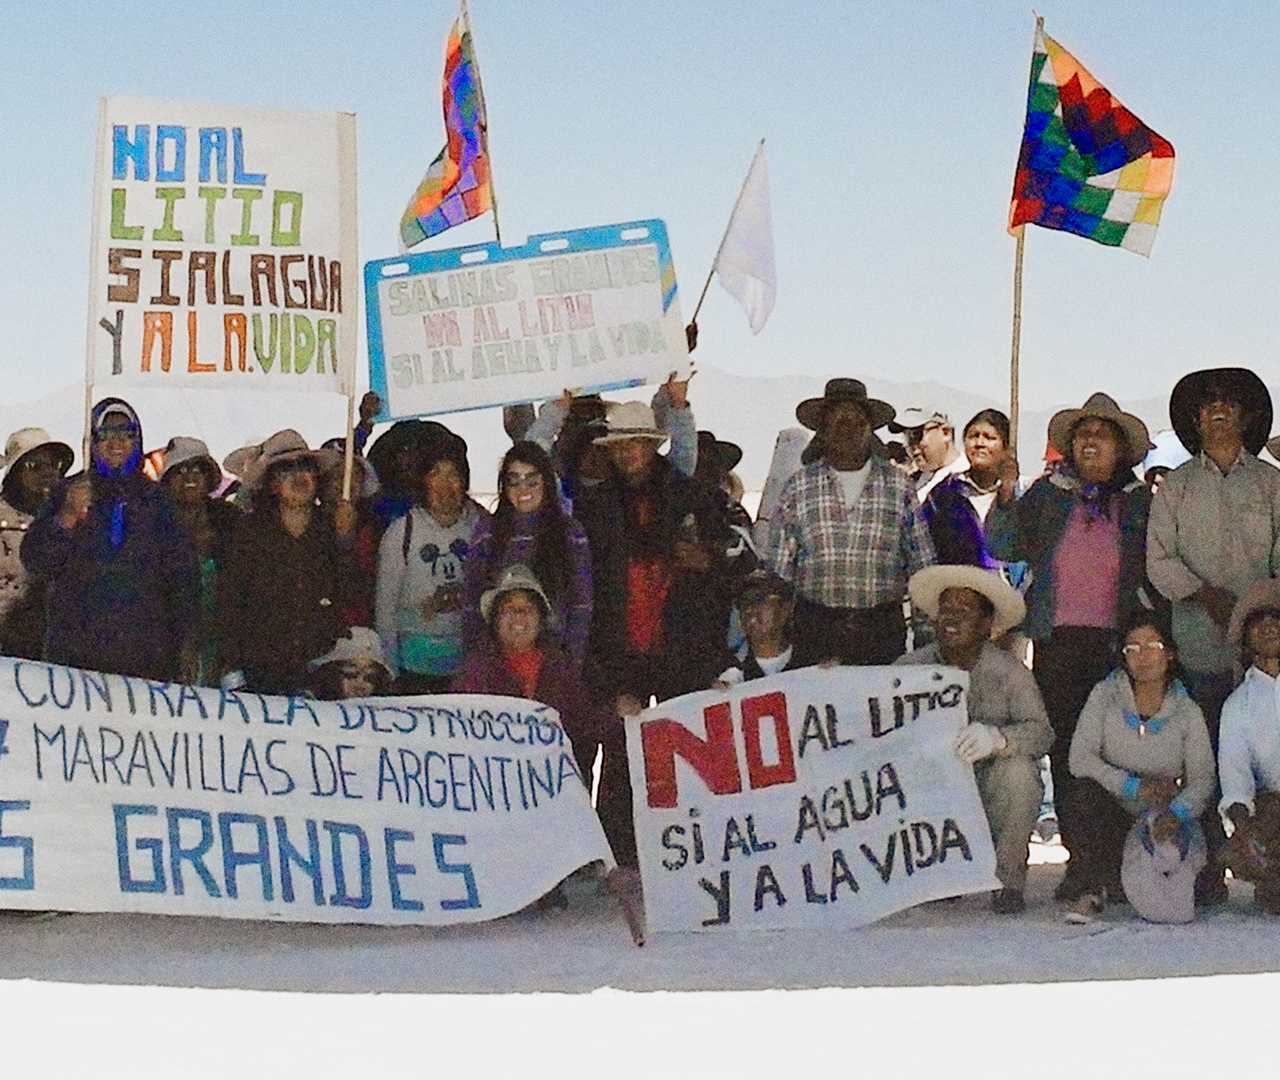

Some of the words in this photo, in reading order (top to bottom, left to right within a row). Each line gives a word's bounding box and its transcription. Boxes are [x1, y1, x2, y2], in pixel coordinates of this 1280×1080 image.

[112, 124, 186, 182] NO
[198, 126, 267, 186] AL
[110, 186, 303, 246] LITIO
[389, 265, 518, 316] SALINAS
[98, 309, 124, 375] Y
[474, 305, 510, 343] AL
[431, 348, 465, 384] AL
[33, 722, 295, 797] MARAVILLAS
[308, 741, 363, 800] DE
[377, 746, 583, 812] ARGENTINA
[640, 690, 797, 809] NO
[797, 703, 853, 758] AL
[721, 814, 776, 863] AL
[794, 761, 907, 844] AGUA
[111, 803, 482, 911] GRANDES
[698, 871, 731, 926] Y
[754, 865, 788, 912] A
[802, 849, 860, 905] LA
